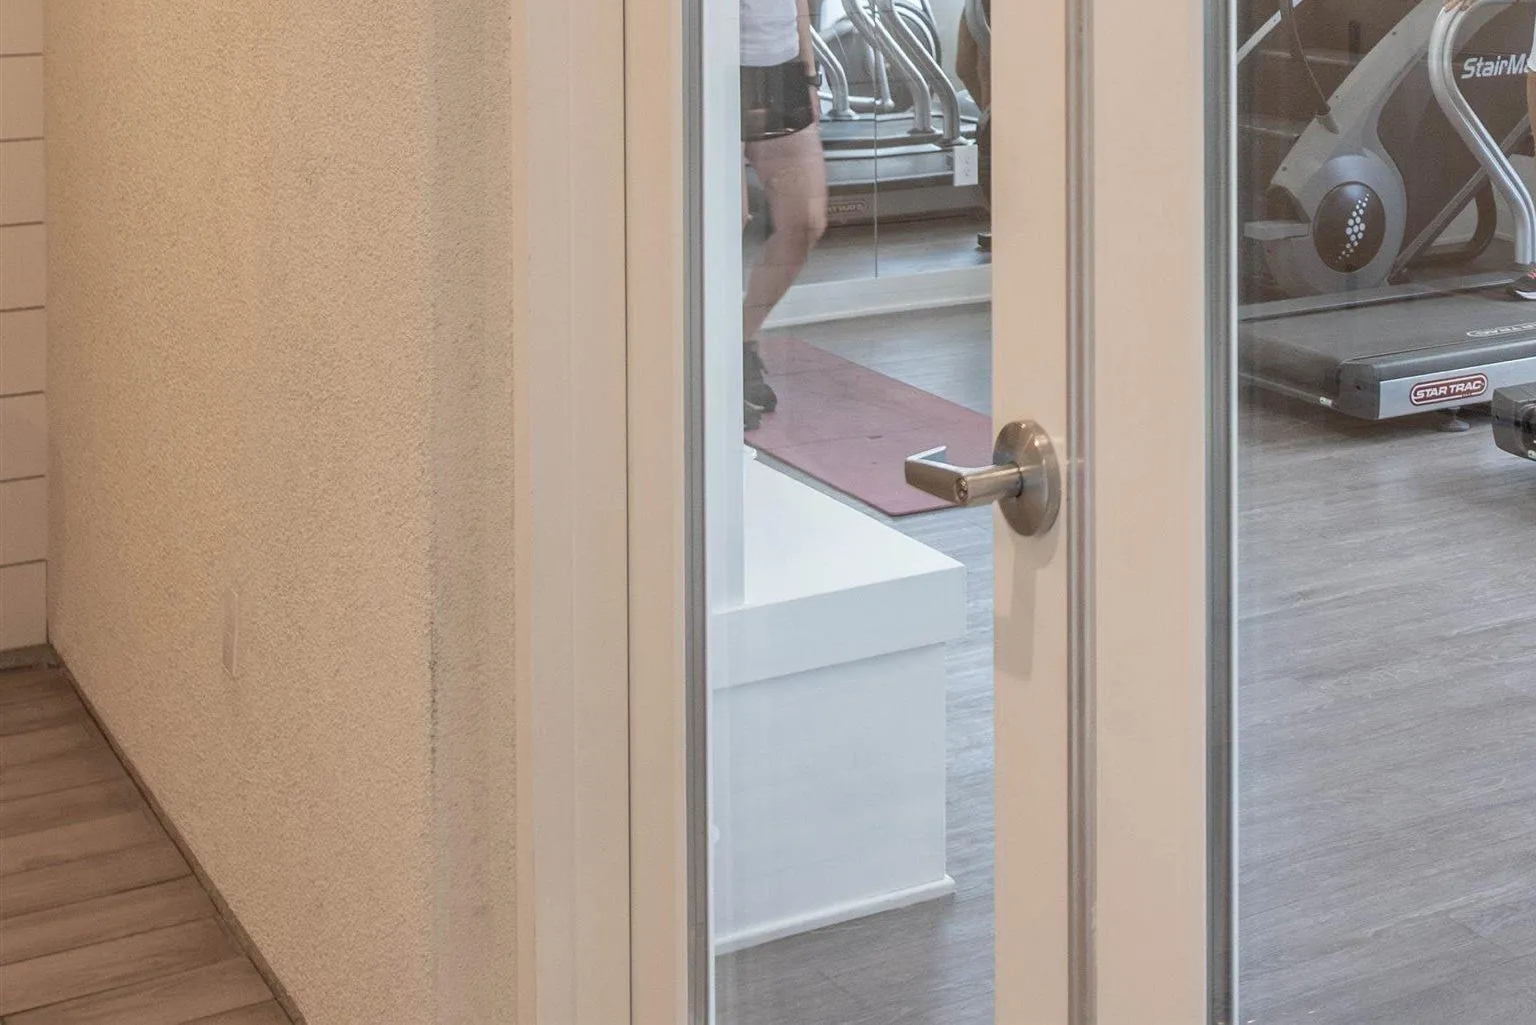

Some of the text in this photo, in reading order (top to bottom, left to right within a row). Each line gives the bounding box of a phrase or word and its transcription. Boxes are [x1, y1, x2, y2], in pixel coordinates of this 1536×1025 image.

[1461, 53, 1529, 79] StairM
[1414, 380, 1482, 399] STAR TRAC
